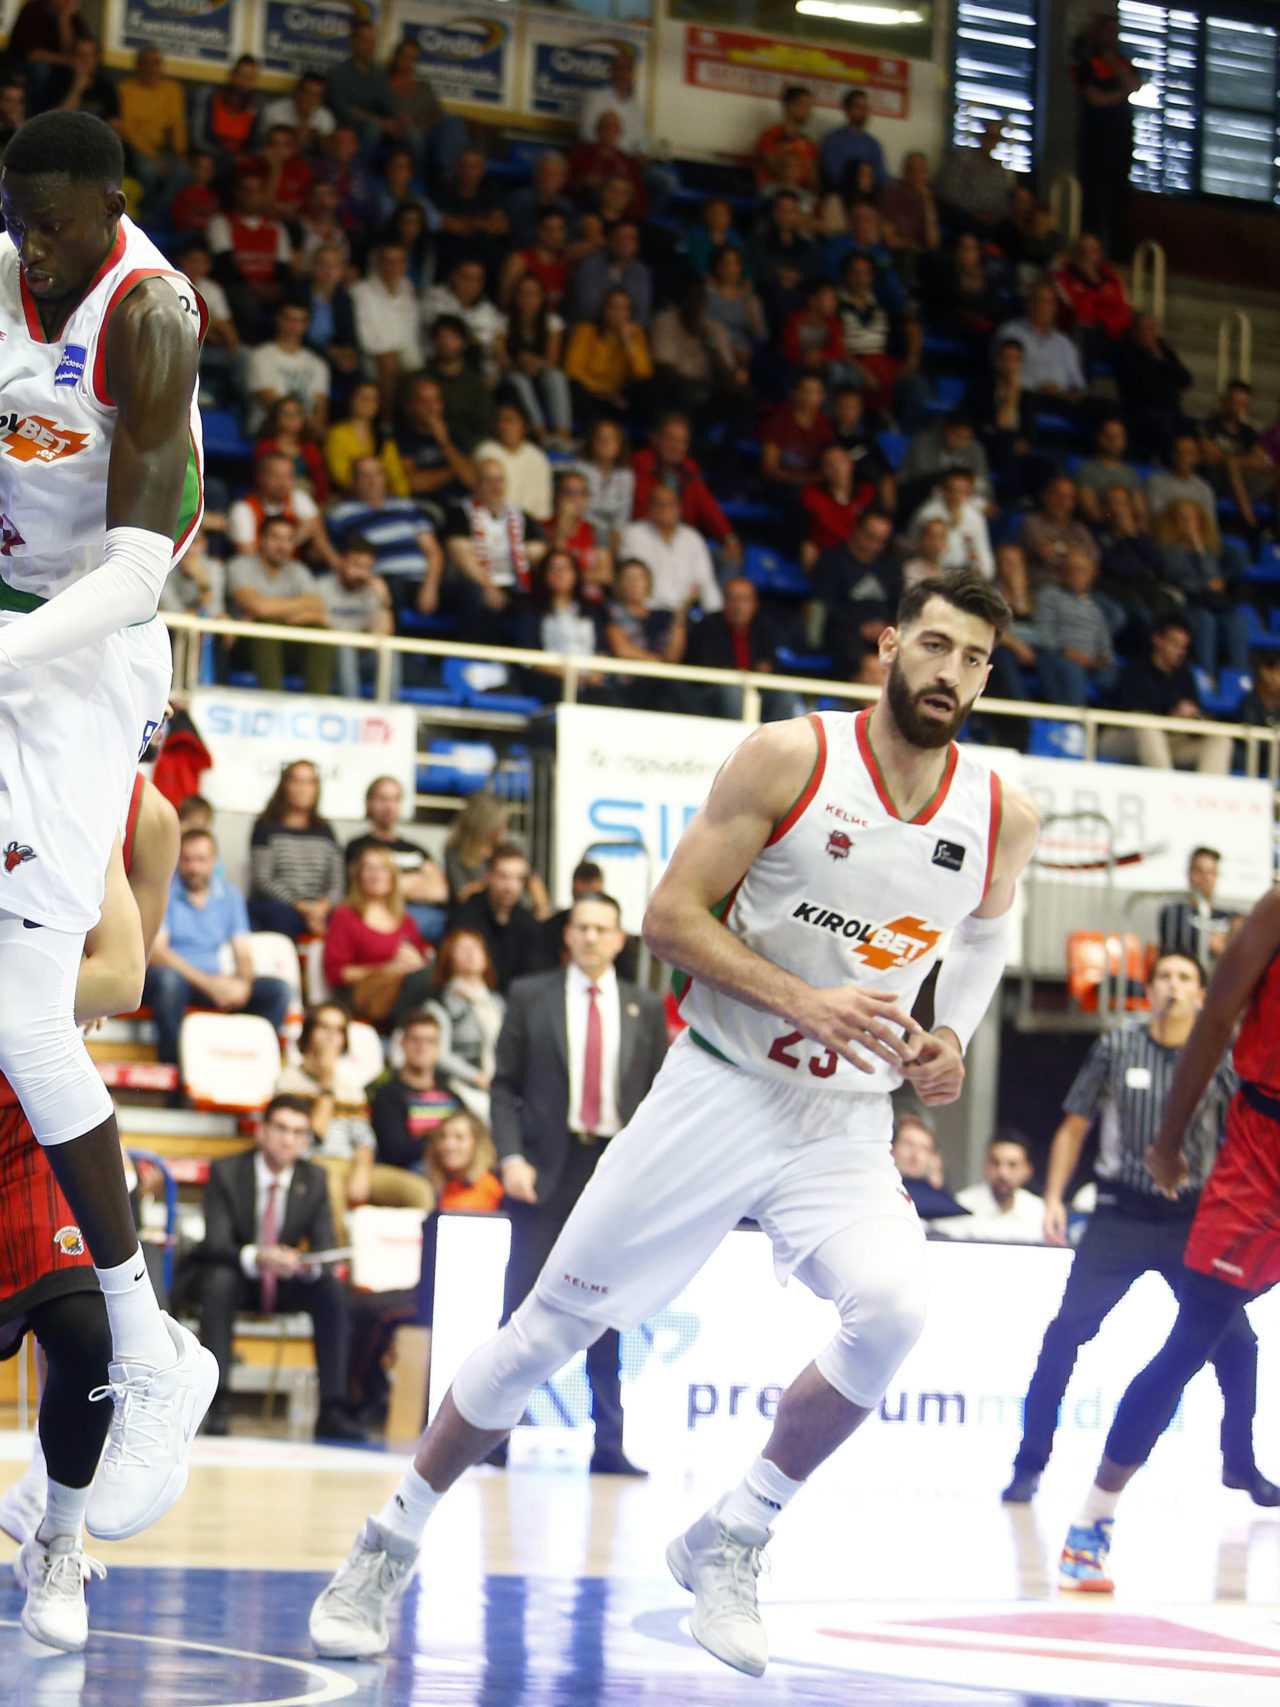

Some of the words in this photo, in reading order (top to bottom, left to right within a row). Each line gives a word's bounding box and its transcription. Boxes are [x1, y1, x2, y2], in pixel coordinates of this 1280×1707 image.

[826, 803, 869, 828] KELME
[793, 902, 928, 959] KIROLBET
[563, 1273, 608, 1294] KELME
